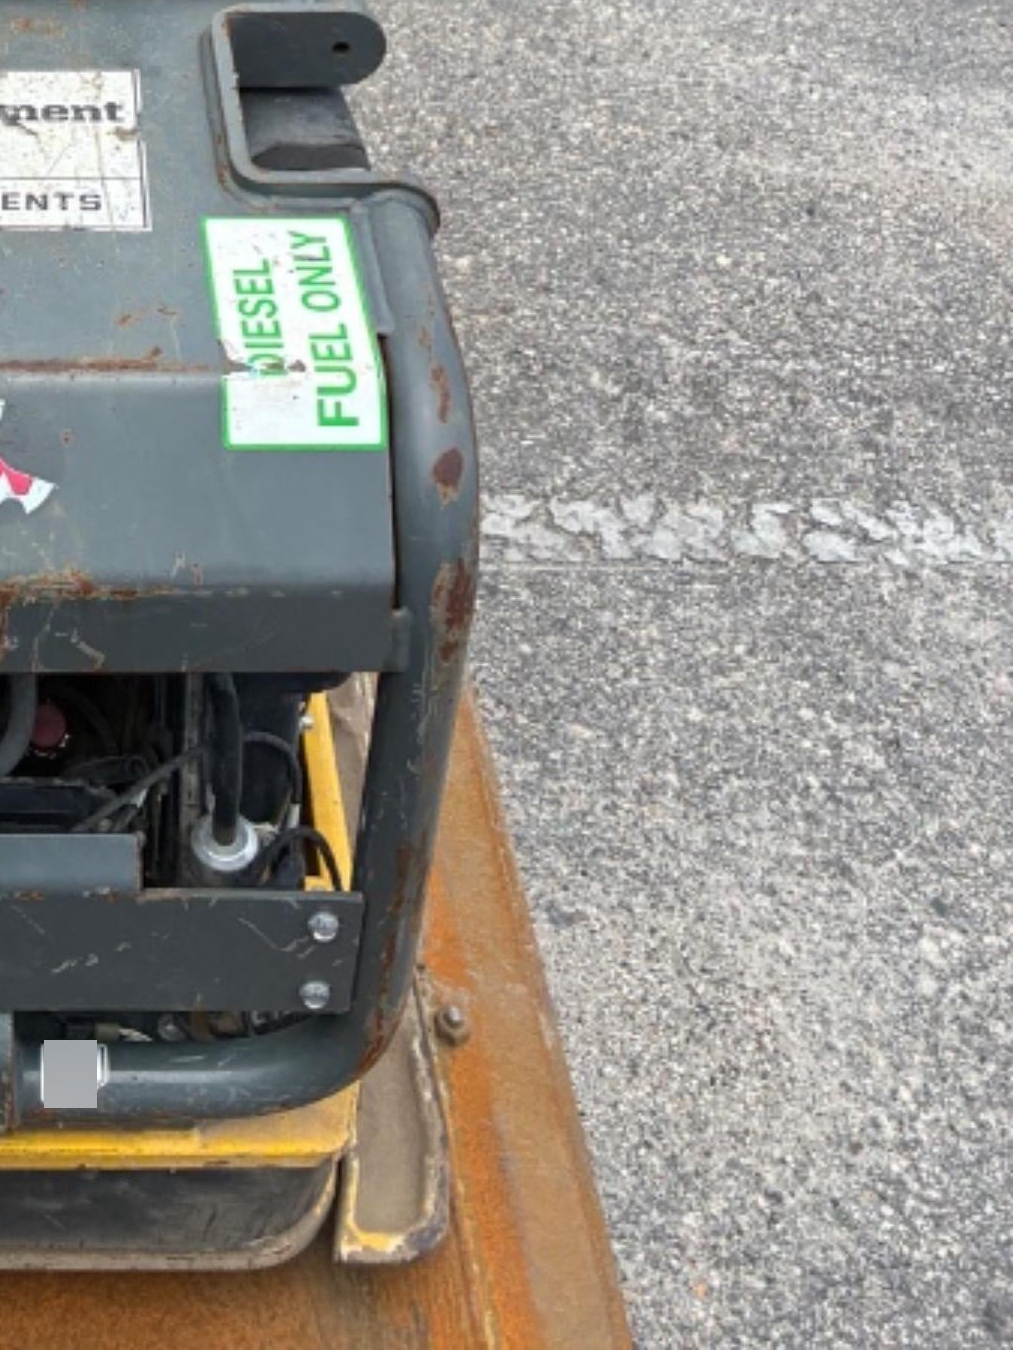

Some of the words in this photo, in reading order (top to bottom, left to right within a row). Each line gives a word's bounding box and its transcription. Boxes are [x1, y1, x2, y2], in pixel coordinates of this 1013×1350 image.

[233, 258, 287, 376] DIESEL
[288, 230, 341, 312] ONLY
[308, 323, 360, 427] FUEL
